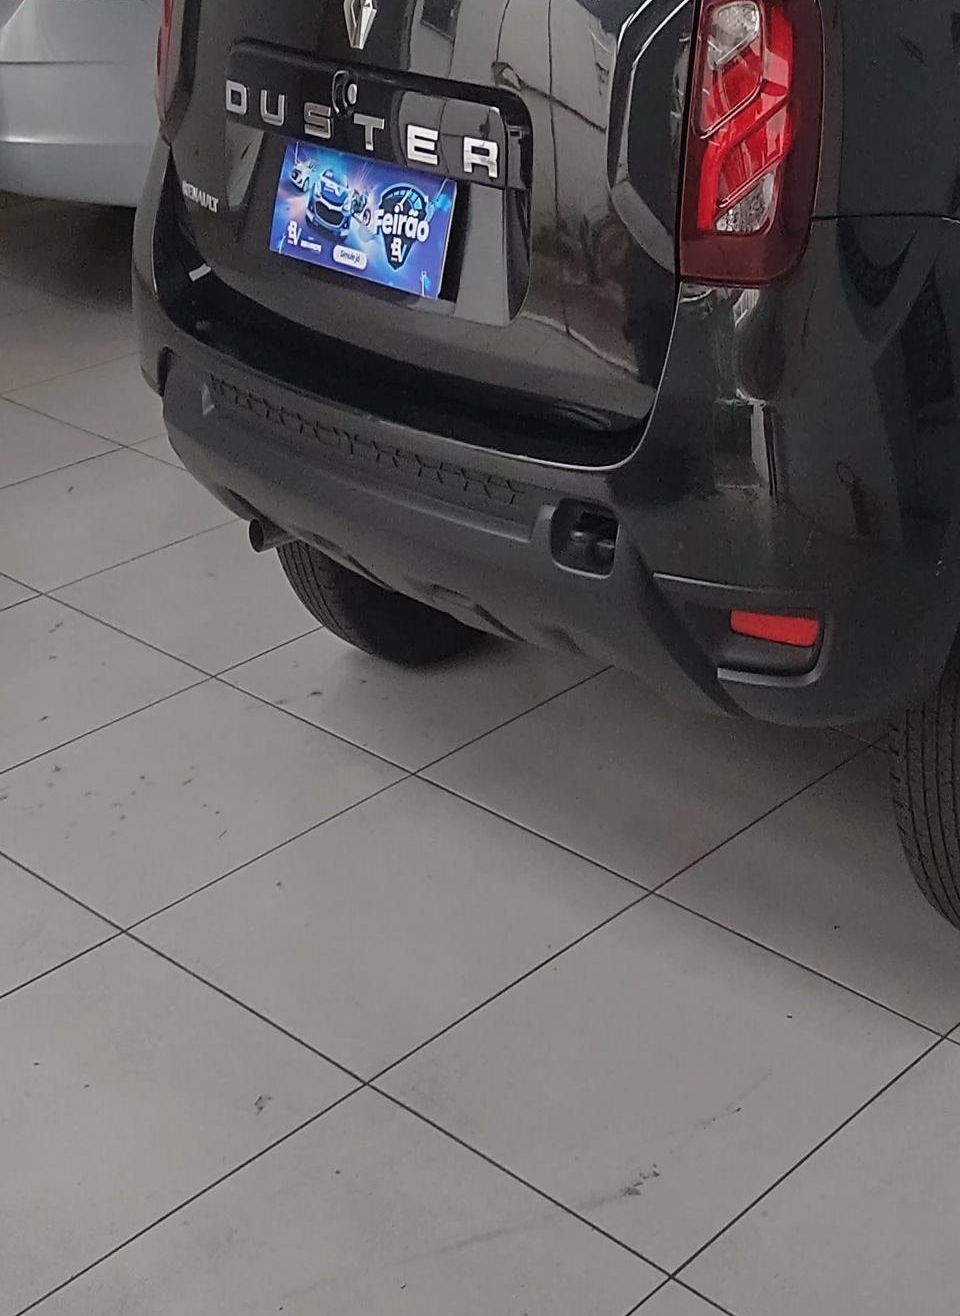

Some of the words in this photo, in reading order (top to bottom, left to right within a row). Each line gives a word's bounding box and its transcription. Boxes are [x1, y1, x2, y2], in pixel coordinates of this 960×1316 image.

[226, 79, 499, 179] DUSTER
[182, 180, 219, 213] RENAULT
[374, 207, 430, 242] Feirão
